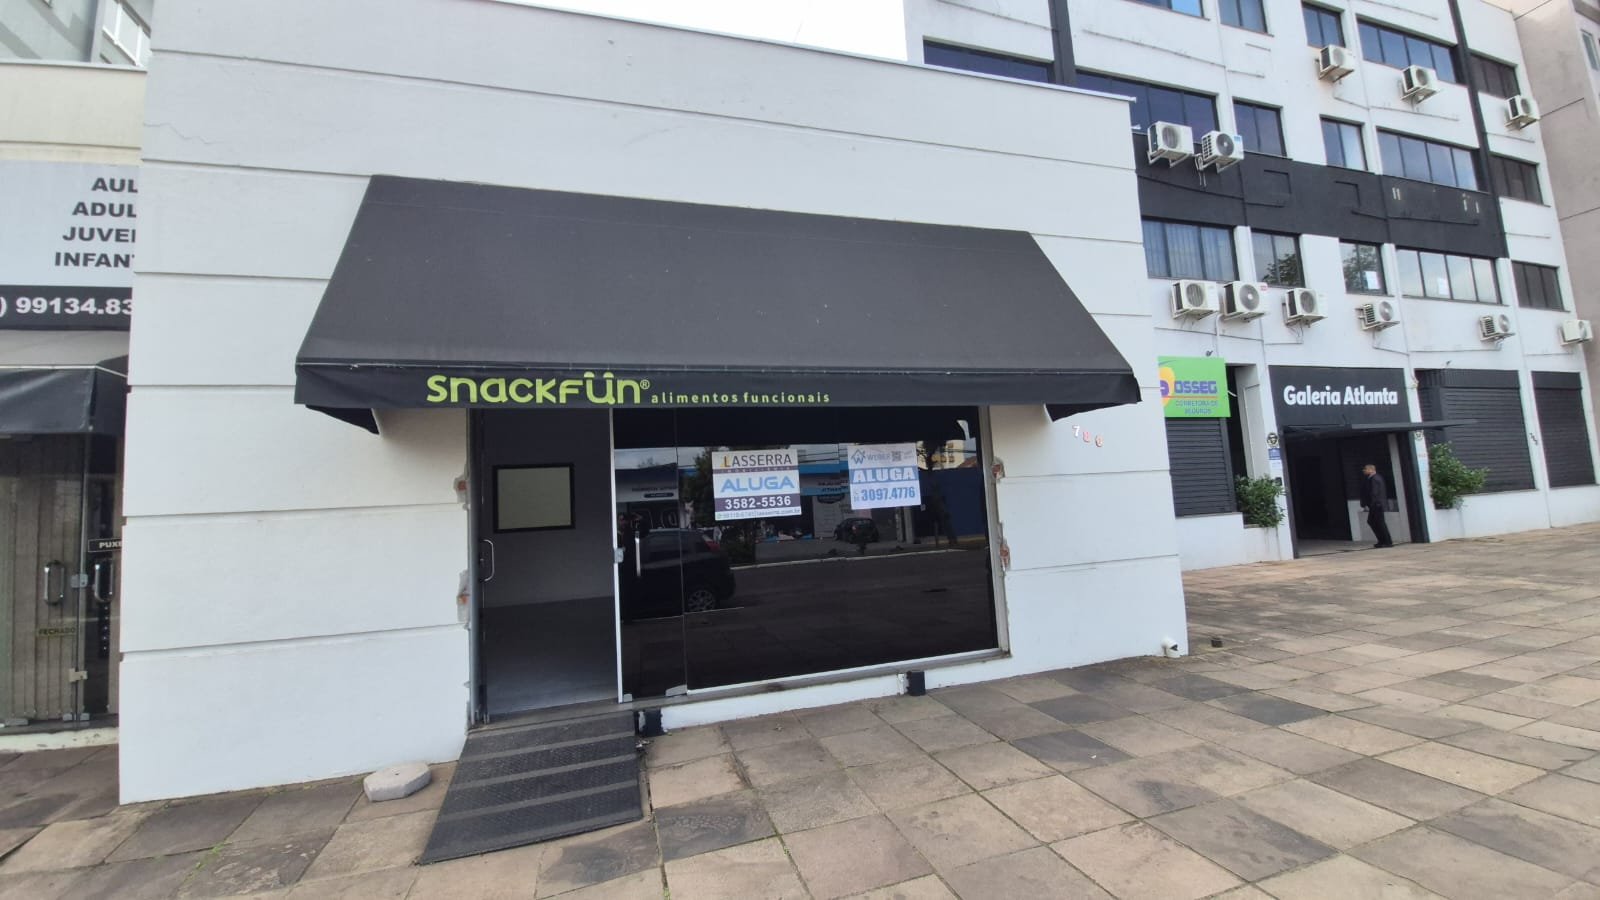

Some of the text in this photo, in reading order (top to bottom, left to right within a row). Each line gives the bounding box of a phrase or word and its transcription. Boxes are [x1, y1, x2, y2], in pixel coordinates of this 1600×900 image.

[54, 251, 135, 268] INFAN
[650, 392, 739, 404] alimentos
[744, 391, 831, 404] funcionais
[1283, 385, 1398, 406] Galeria Atlanta
[722, 453, 793, 468] LASSERRA
[852, 467, 916, 483] ALUGA
[720, 475, 795, 493] ALUGA
[860, 486, 915, 501] 3097.4776
[724, 495, 791, 510] 3582-5536
